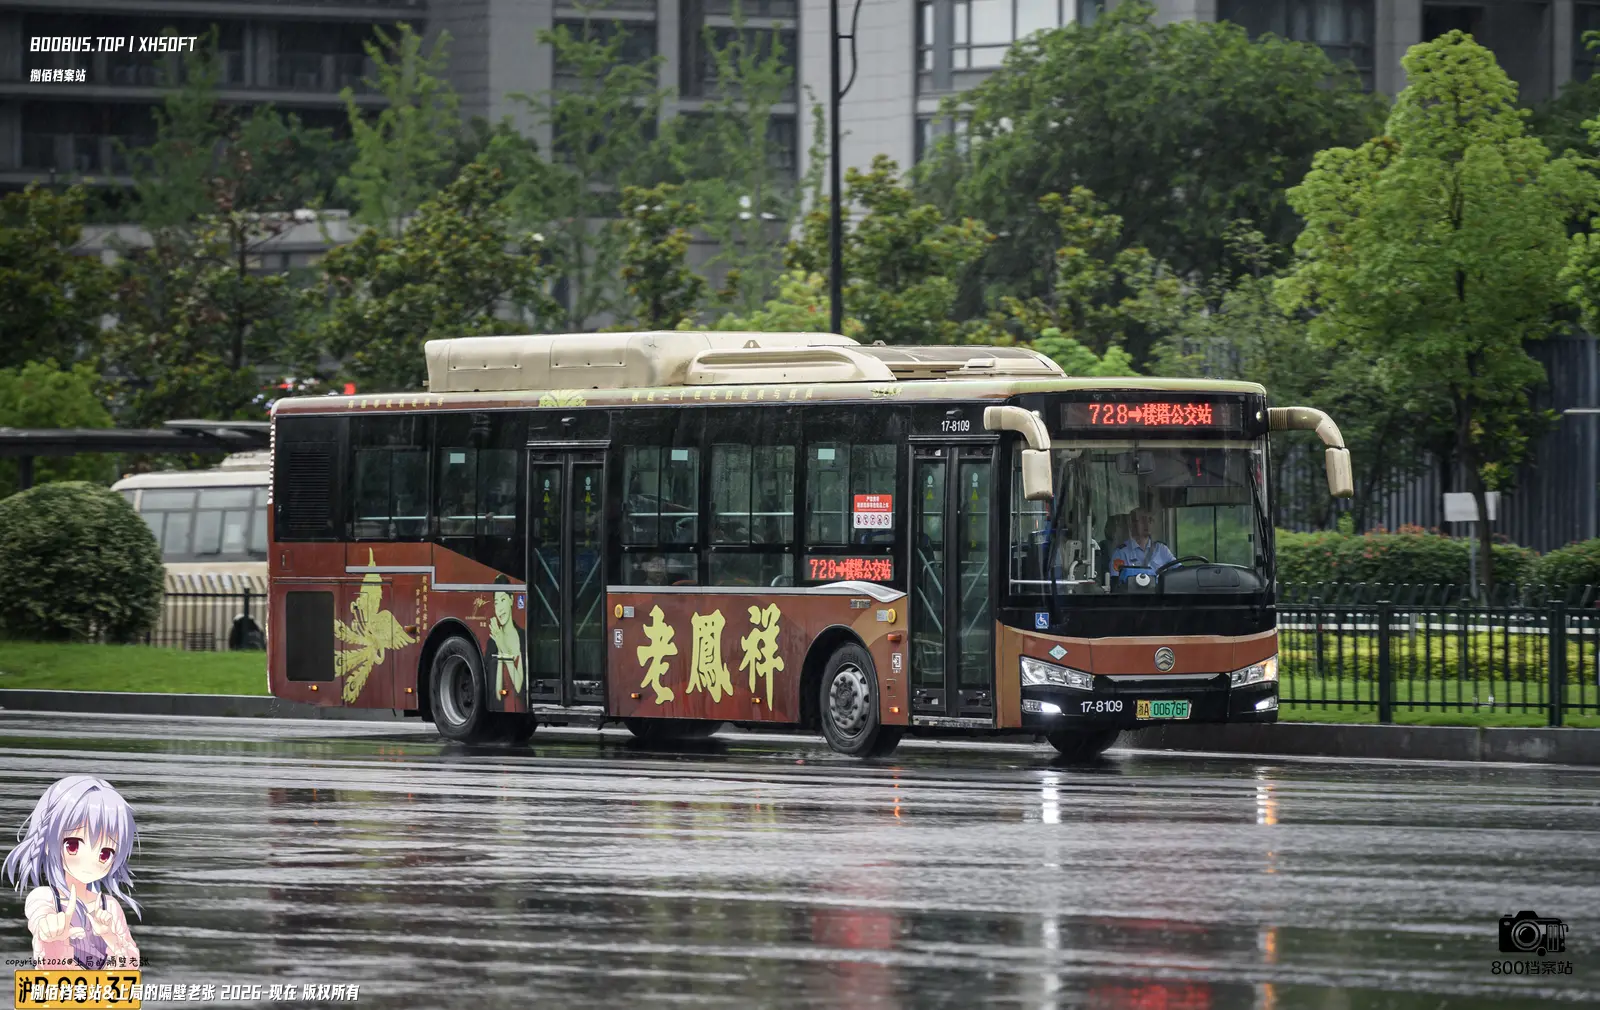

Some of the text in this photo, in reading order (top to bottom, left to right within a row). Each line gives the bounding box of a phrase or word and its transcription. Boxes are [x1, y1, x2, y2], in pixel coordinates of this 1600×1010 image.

[1089, 403, 1212, 425] 728 楼塔公交站
[941, 420, 970, 431] 17-8109
[810, 559, 836, 579] 728
[1080, 700, 1123, 713] 17-8109
